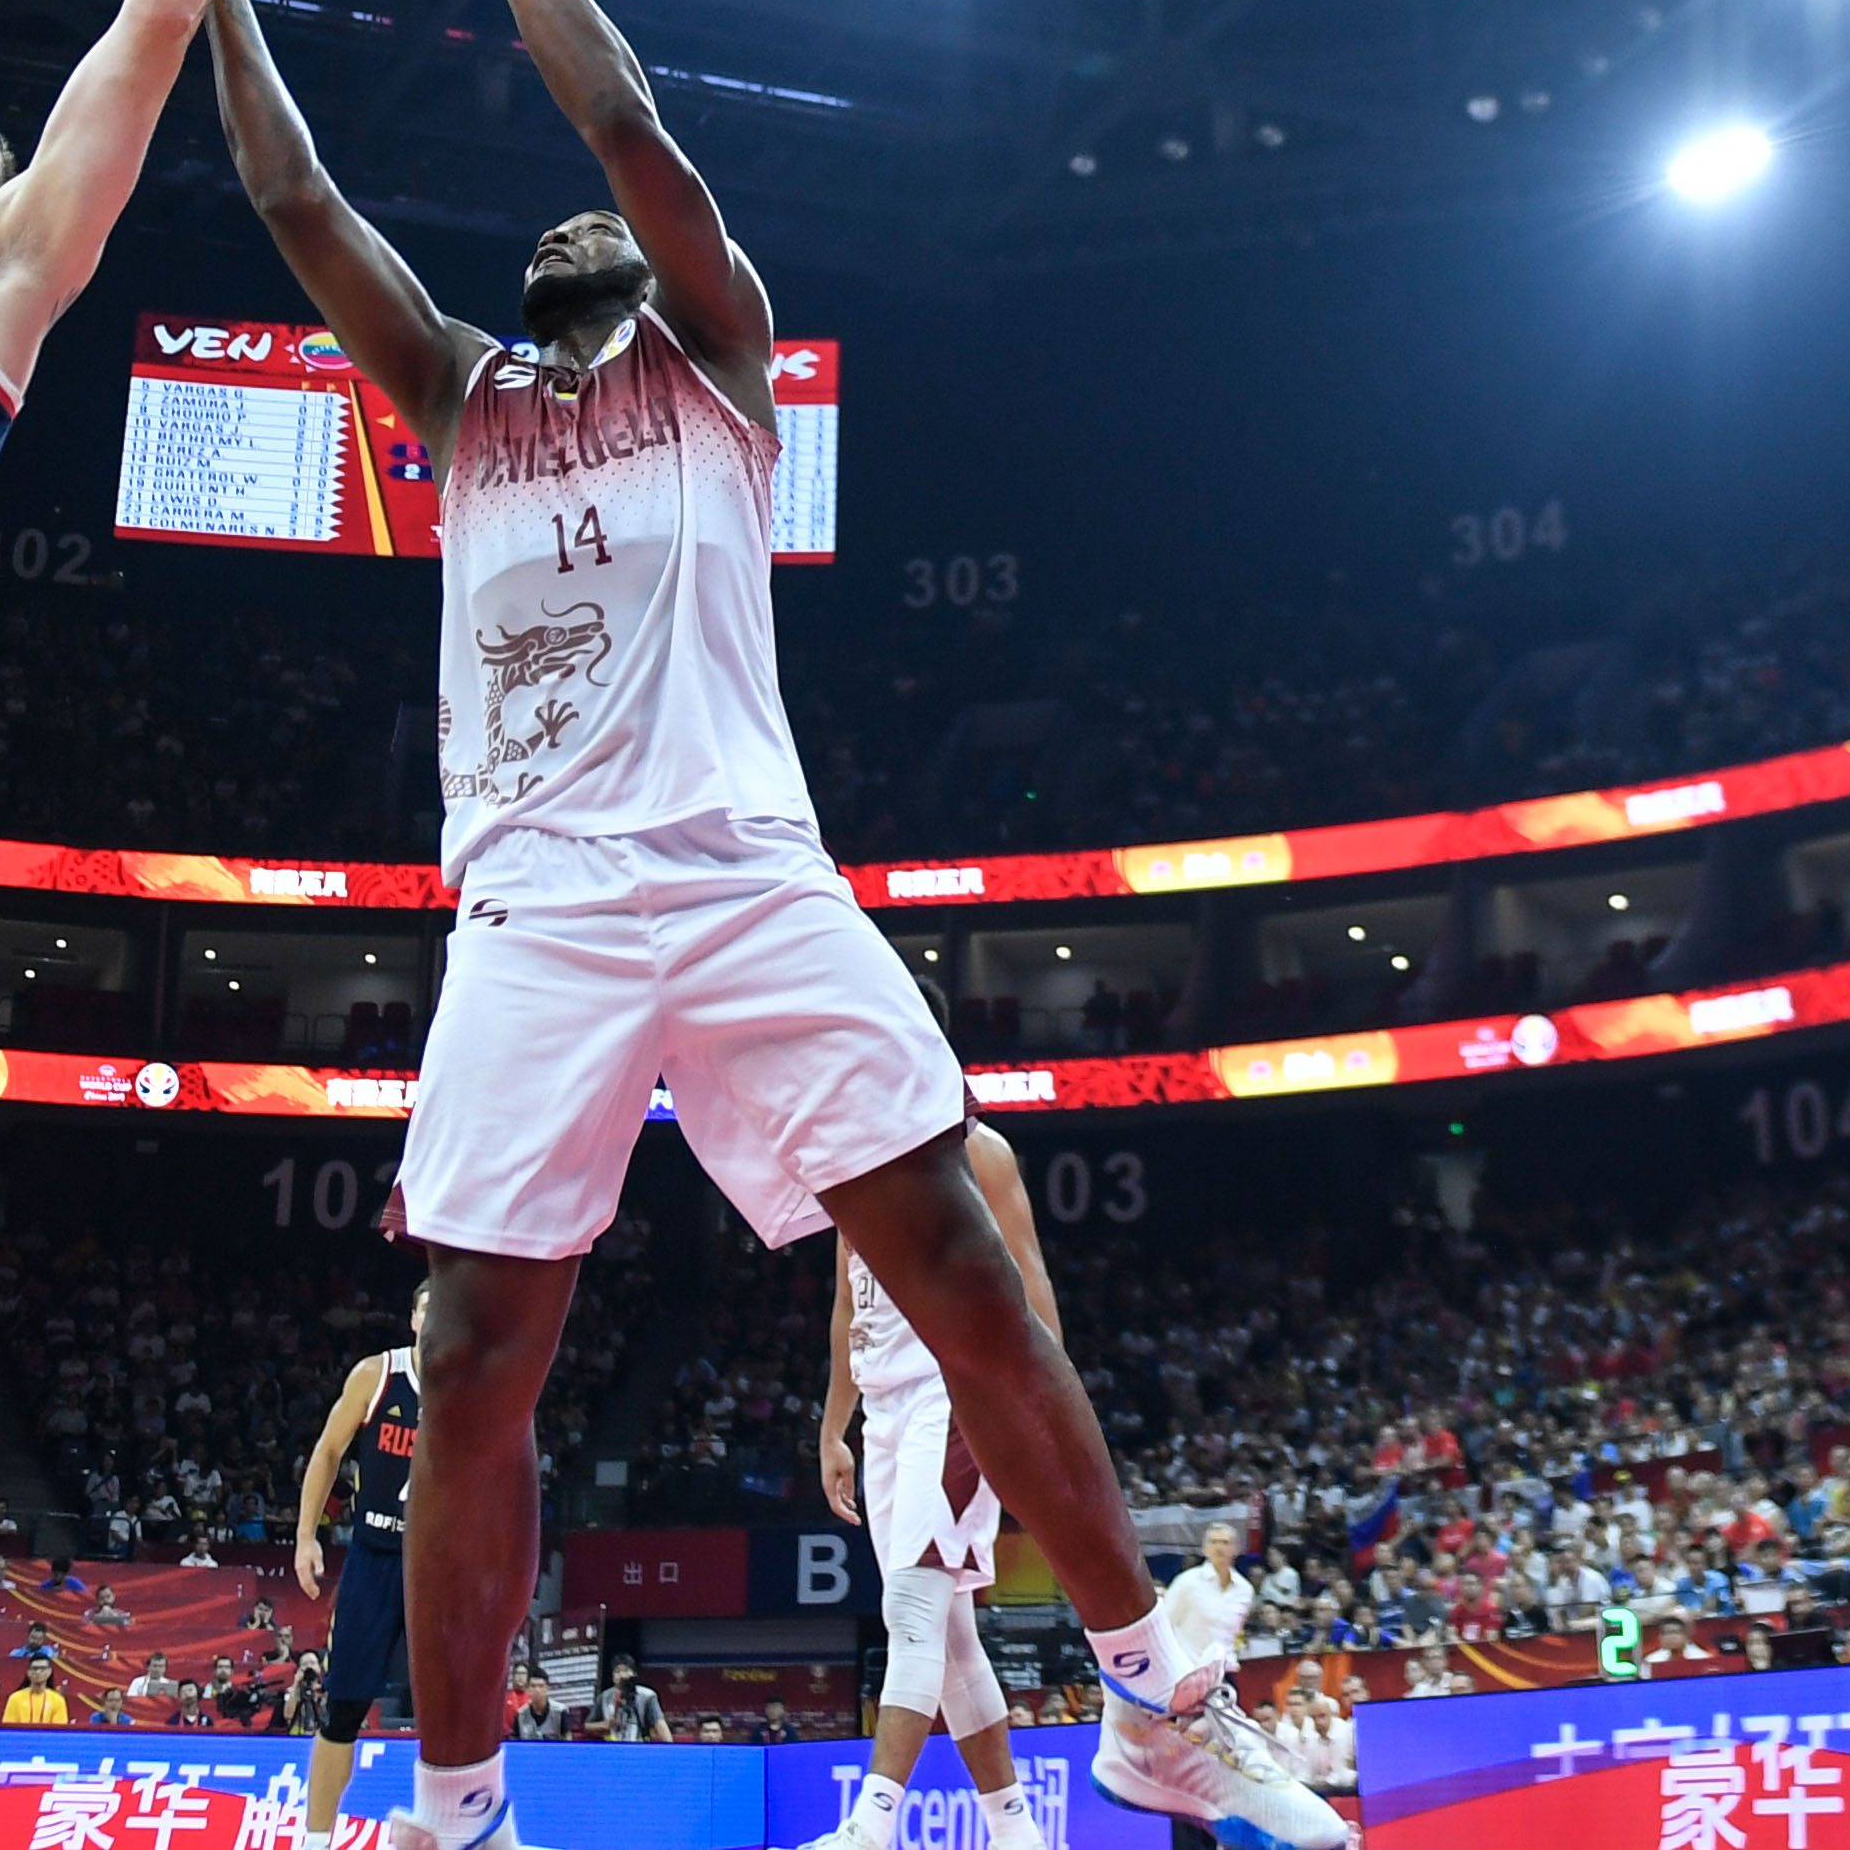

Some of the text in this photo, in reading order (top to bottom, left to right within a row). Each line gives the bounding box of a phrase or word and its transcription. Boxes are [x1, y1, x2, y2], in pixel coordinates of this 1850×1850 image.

[153, 324, 272, 362] VEN
[551, 504, 613, 575] 14
[1449, 499, 1570, 569] 304
[902, 553, 1023, 609] 303
[1019, 1152, 1147, 1223] 03
[623, 1560, 679, 1585] 出口
[796, 1533, 851, 1605] B
[1600, 1608, 1640, 1677] 2
